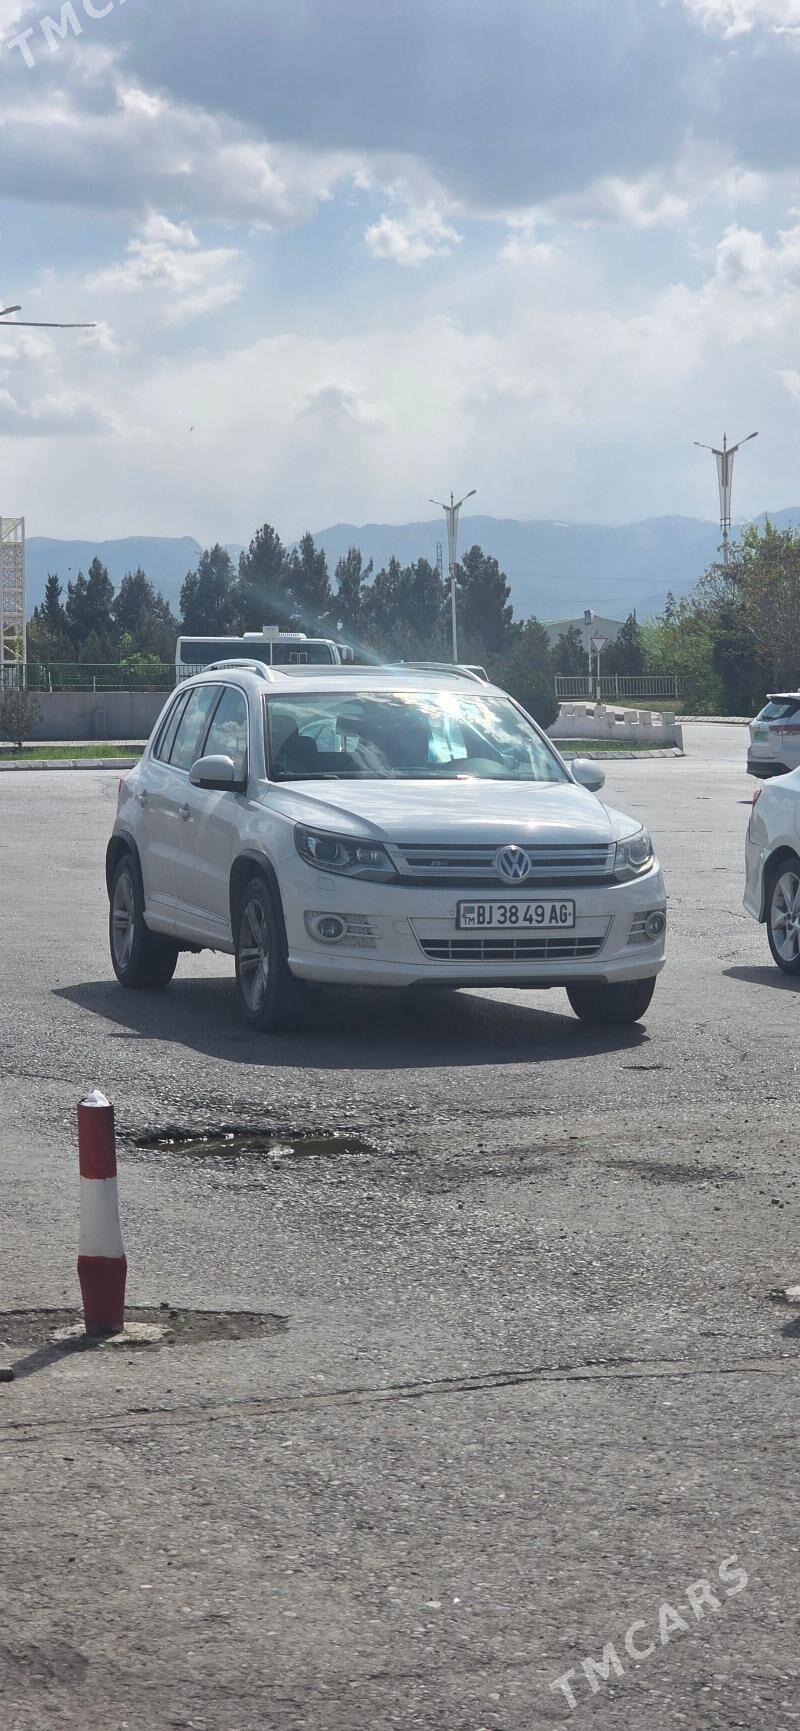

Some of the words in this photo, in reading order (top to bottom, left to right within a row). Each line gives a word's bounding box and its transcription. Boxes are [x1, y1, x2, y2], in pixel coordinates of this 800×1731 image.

[463, 916, 475, 926] TM
[477, 905, 493, 925] BJ
[497, 905, 519, 925] 38
[523, 904, 545, 924] 49
[548, 904, 568, 924] AG
